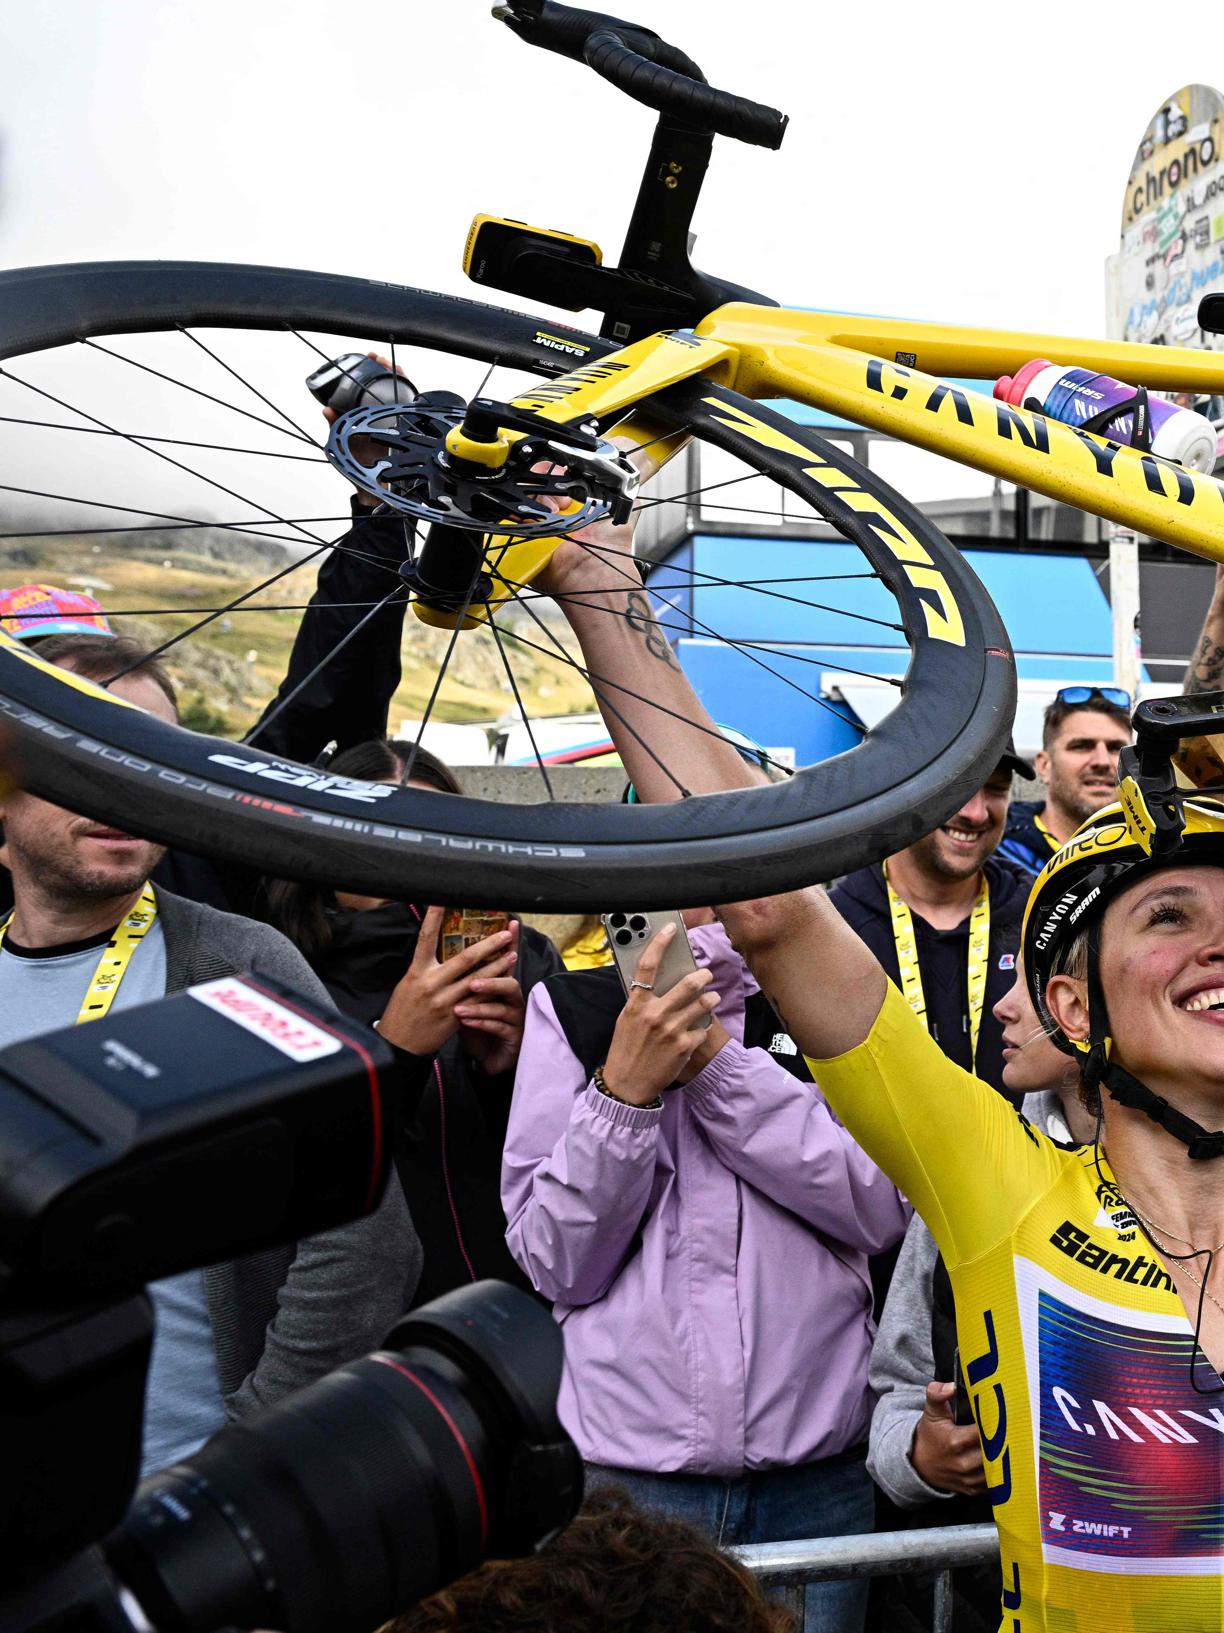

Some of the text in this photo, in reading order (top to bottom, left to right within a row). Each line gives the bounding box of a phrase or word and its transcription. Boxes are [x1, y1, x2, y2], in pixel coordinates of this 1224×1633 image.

[1133, 136, 1215, 215] chrono
[476, 260, 487, 279] Karoo
[532, 335, 586, 358] SAPIM
[1058, 379, 1106, 401] SRAM
[700, 396, 967, 648] ZIPP
[208, 753, 377, 803] ZIPP
[1124, 795, 1147, 836] TIME
[371, 824, 586, 859] SCHWALBE
[1035, 892, 1079, 950] CANYON
[1069, 886, 1101, 925] SRAM
[1117, 1231, 1136, 1242] 2024
[966, 1309, 1012, 1507] LCL
[1072, 1520, 1132, 1539] ZWIFT
